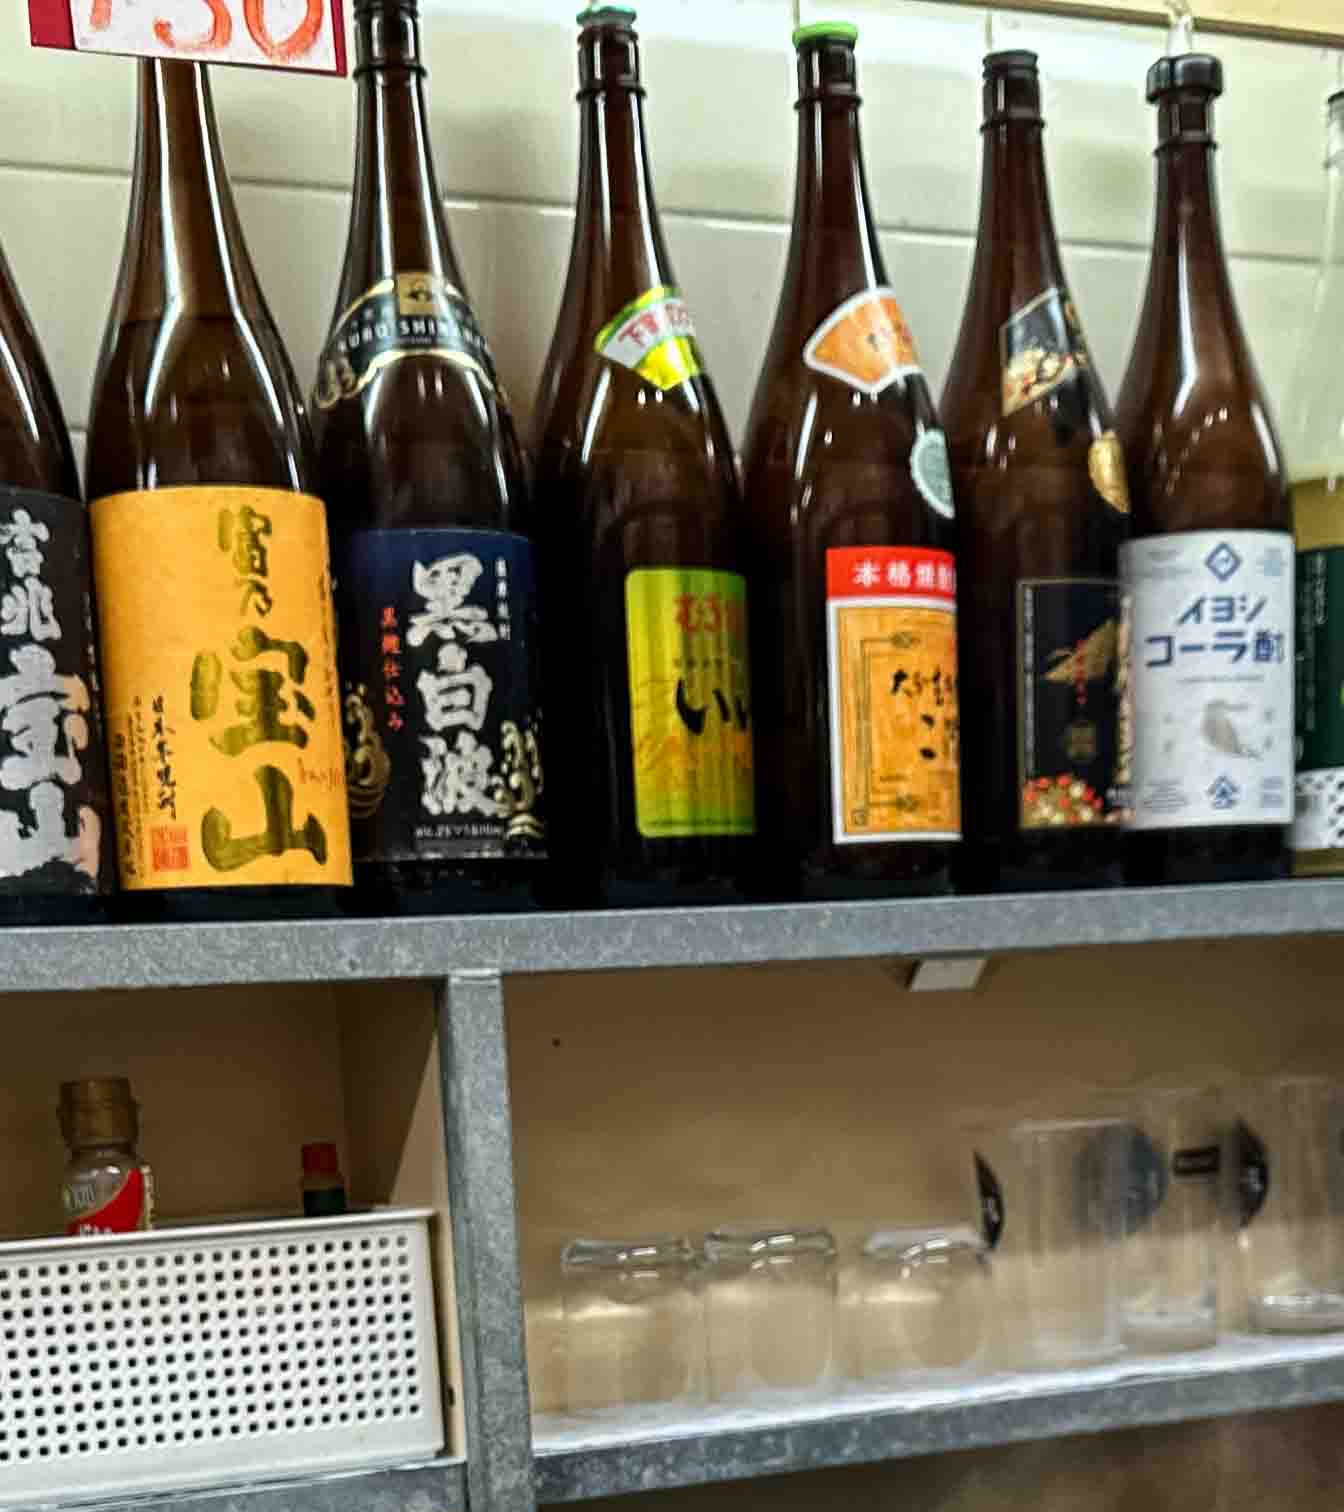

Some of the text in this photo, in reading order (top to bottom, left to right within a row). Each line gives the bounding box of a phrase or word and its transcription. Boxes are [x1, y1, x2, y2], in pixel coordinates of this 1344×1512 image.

[1176, 597, 1269, 625] イヨシ
[406, 552, 499, 817] 黒白波
